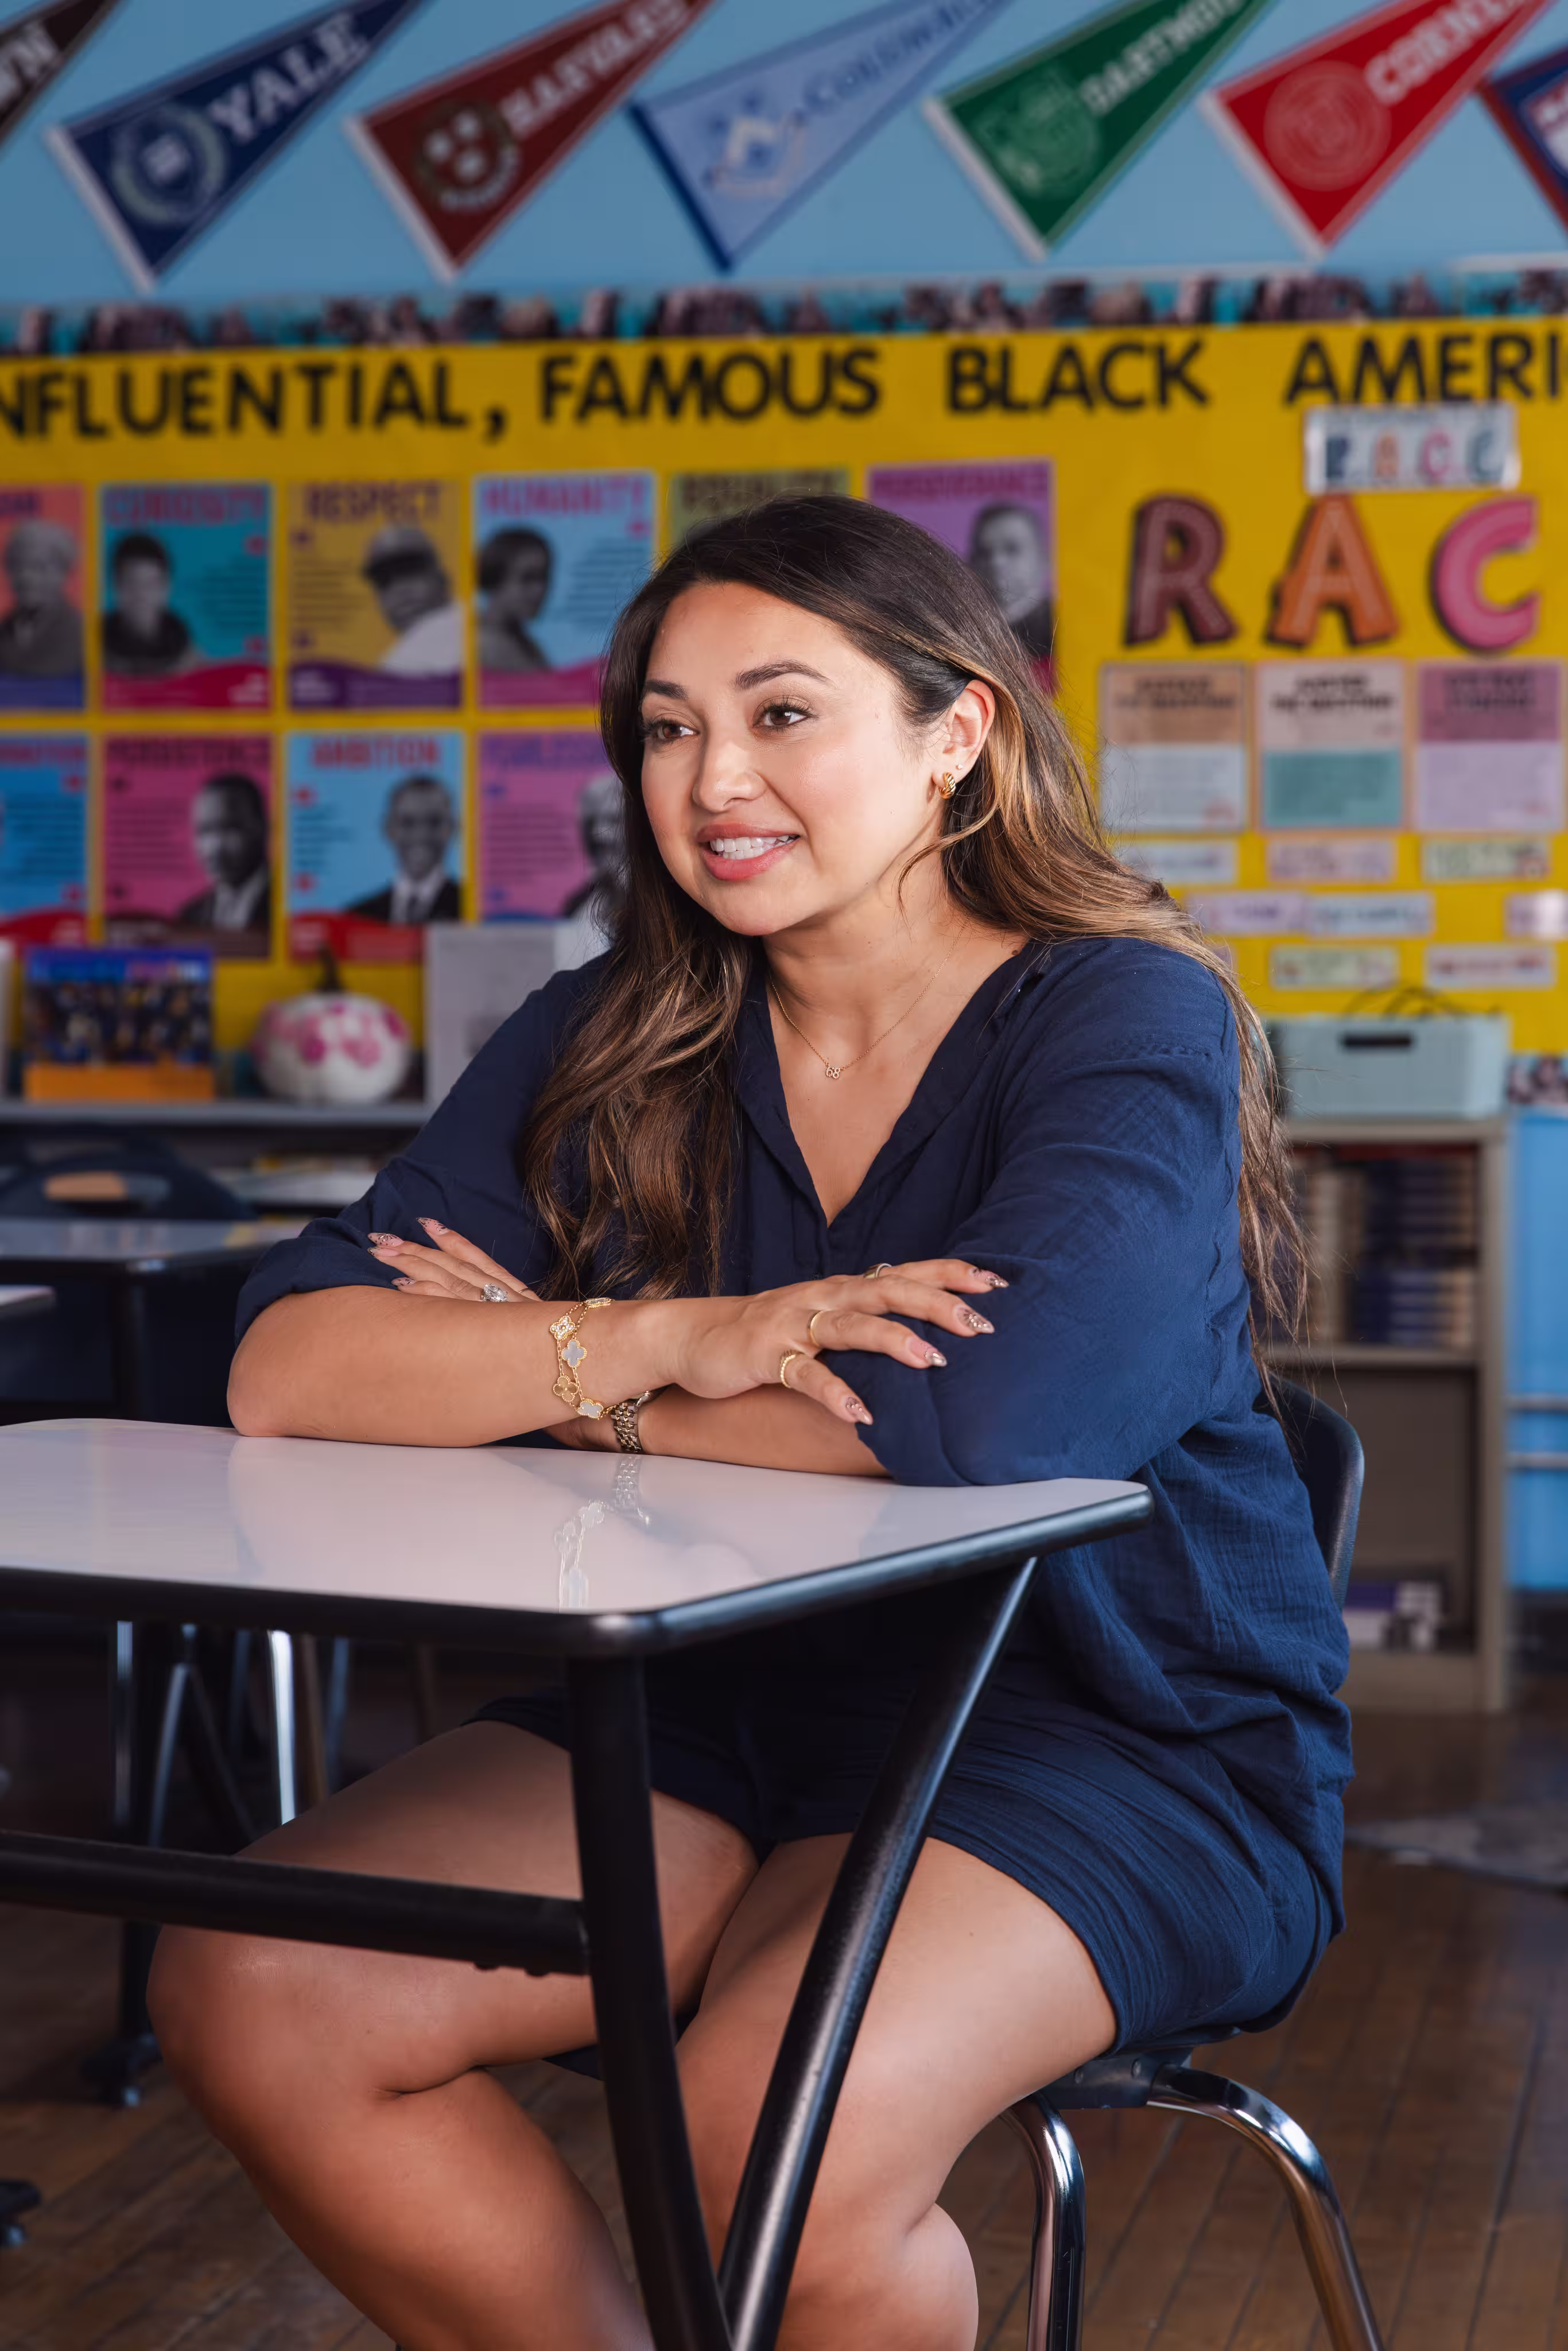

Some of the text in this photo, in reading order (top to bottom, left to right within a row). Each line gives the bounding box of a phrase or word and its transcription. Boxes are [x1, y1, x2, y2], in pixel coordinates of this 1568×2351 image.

[210, 11, 371, 144] YALE
[498, 0, 689, 138] HARVARD
[540, 348, 880, 424] FAMOUS
[947, 335, 1211, 414] BLACK
[1283, 331, 1560, 408] AMERI
